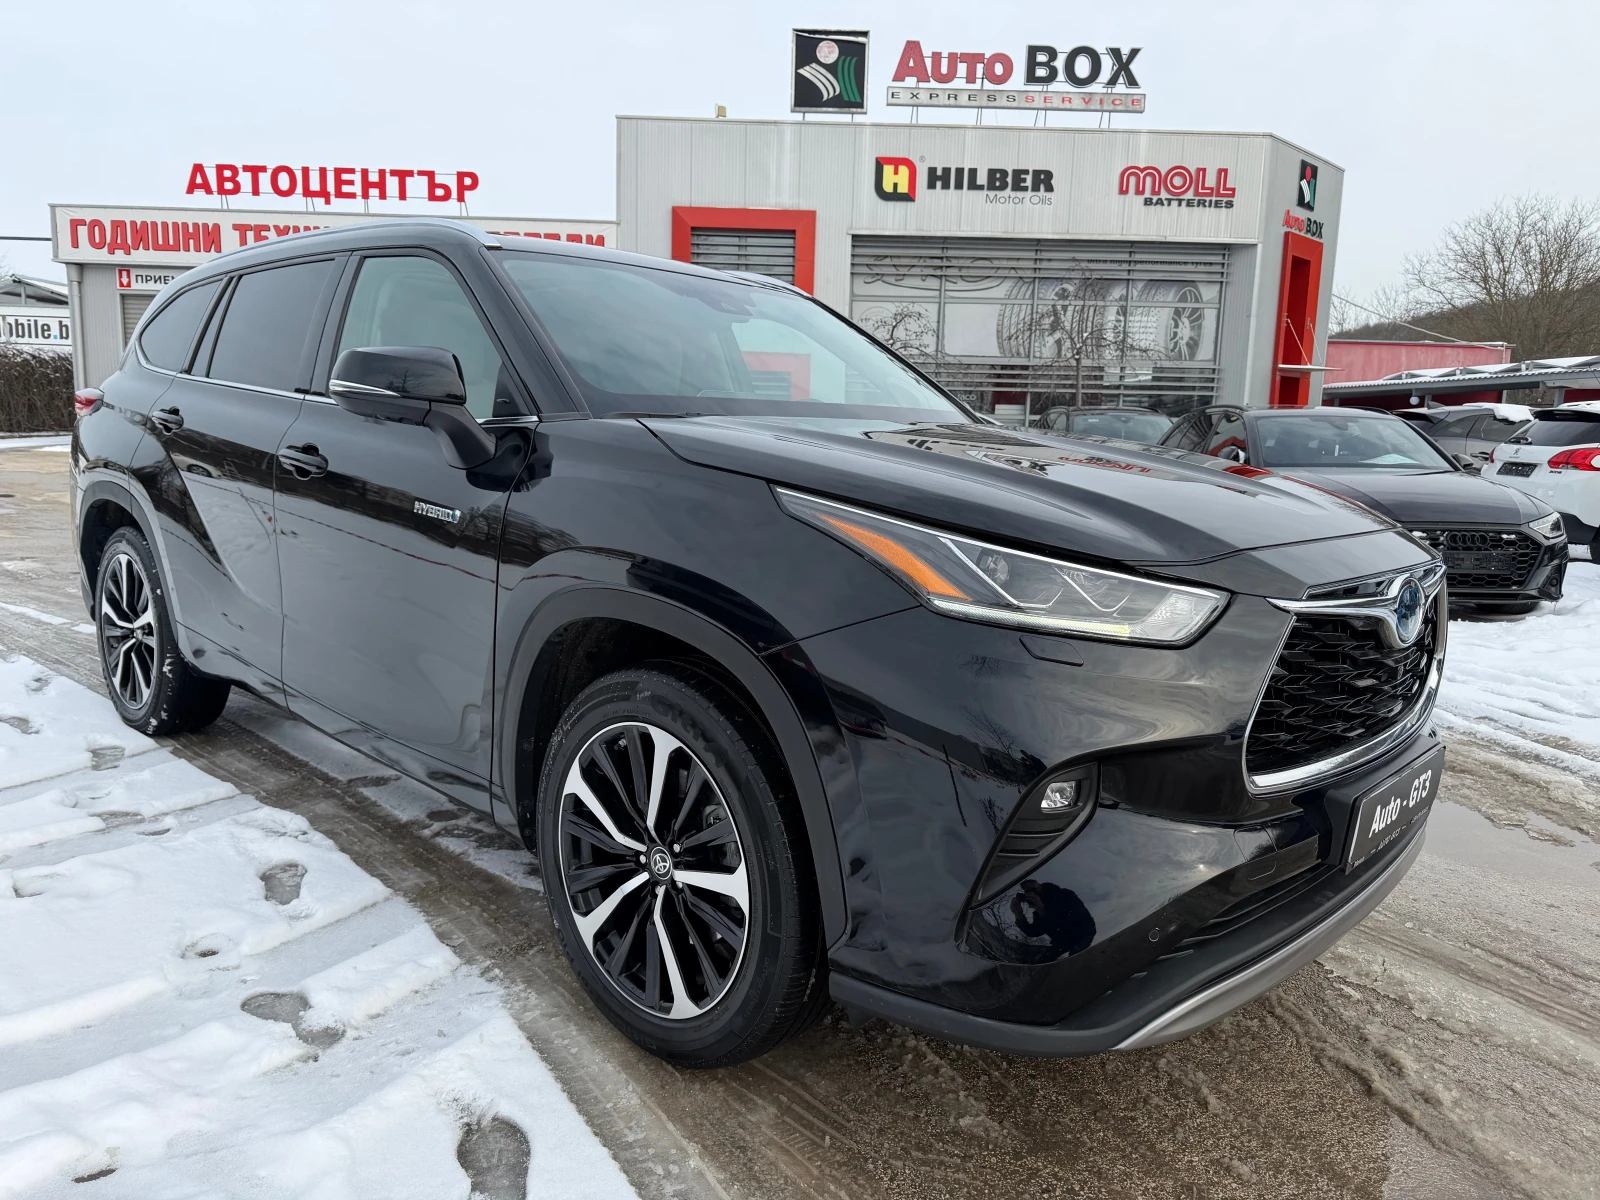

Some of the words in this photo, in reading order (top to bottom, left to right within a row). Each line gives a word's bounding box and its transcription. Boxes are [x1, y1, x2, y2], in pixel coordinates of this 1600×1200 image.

[1024, 44, 1144, 88] BOX
[891, 91, 1017, 103] EXPRESS
[1024, 95, 1143, 107] SERVICE
[185, 163, 479, 205] АВТОЦЕНТЪР
[927, 166, 1055, 192] HILBER
[985, 193, 1025, 206] Motor
[1029, 194, 1053, 206] Oils
[1143, 197, 1235, 209] BATTERIES
[69, 218, 222, 256] ГОДИШНИ
[1305, 216, 1325, 240] BOX
[135, 274, 175, 285] ПРИЕ
[413, 501, 453, 522] HYBRID
[1368, 796, 1401, 838] Auto
[1408, 769, 1432, 808] GT3
